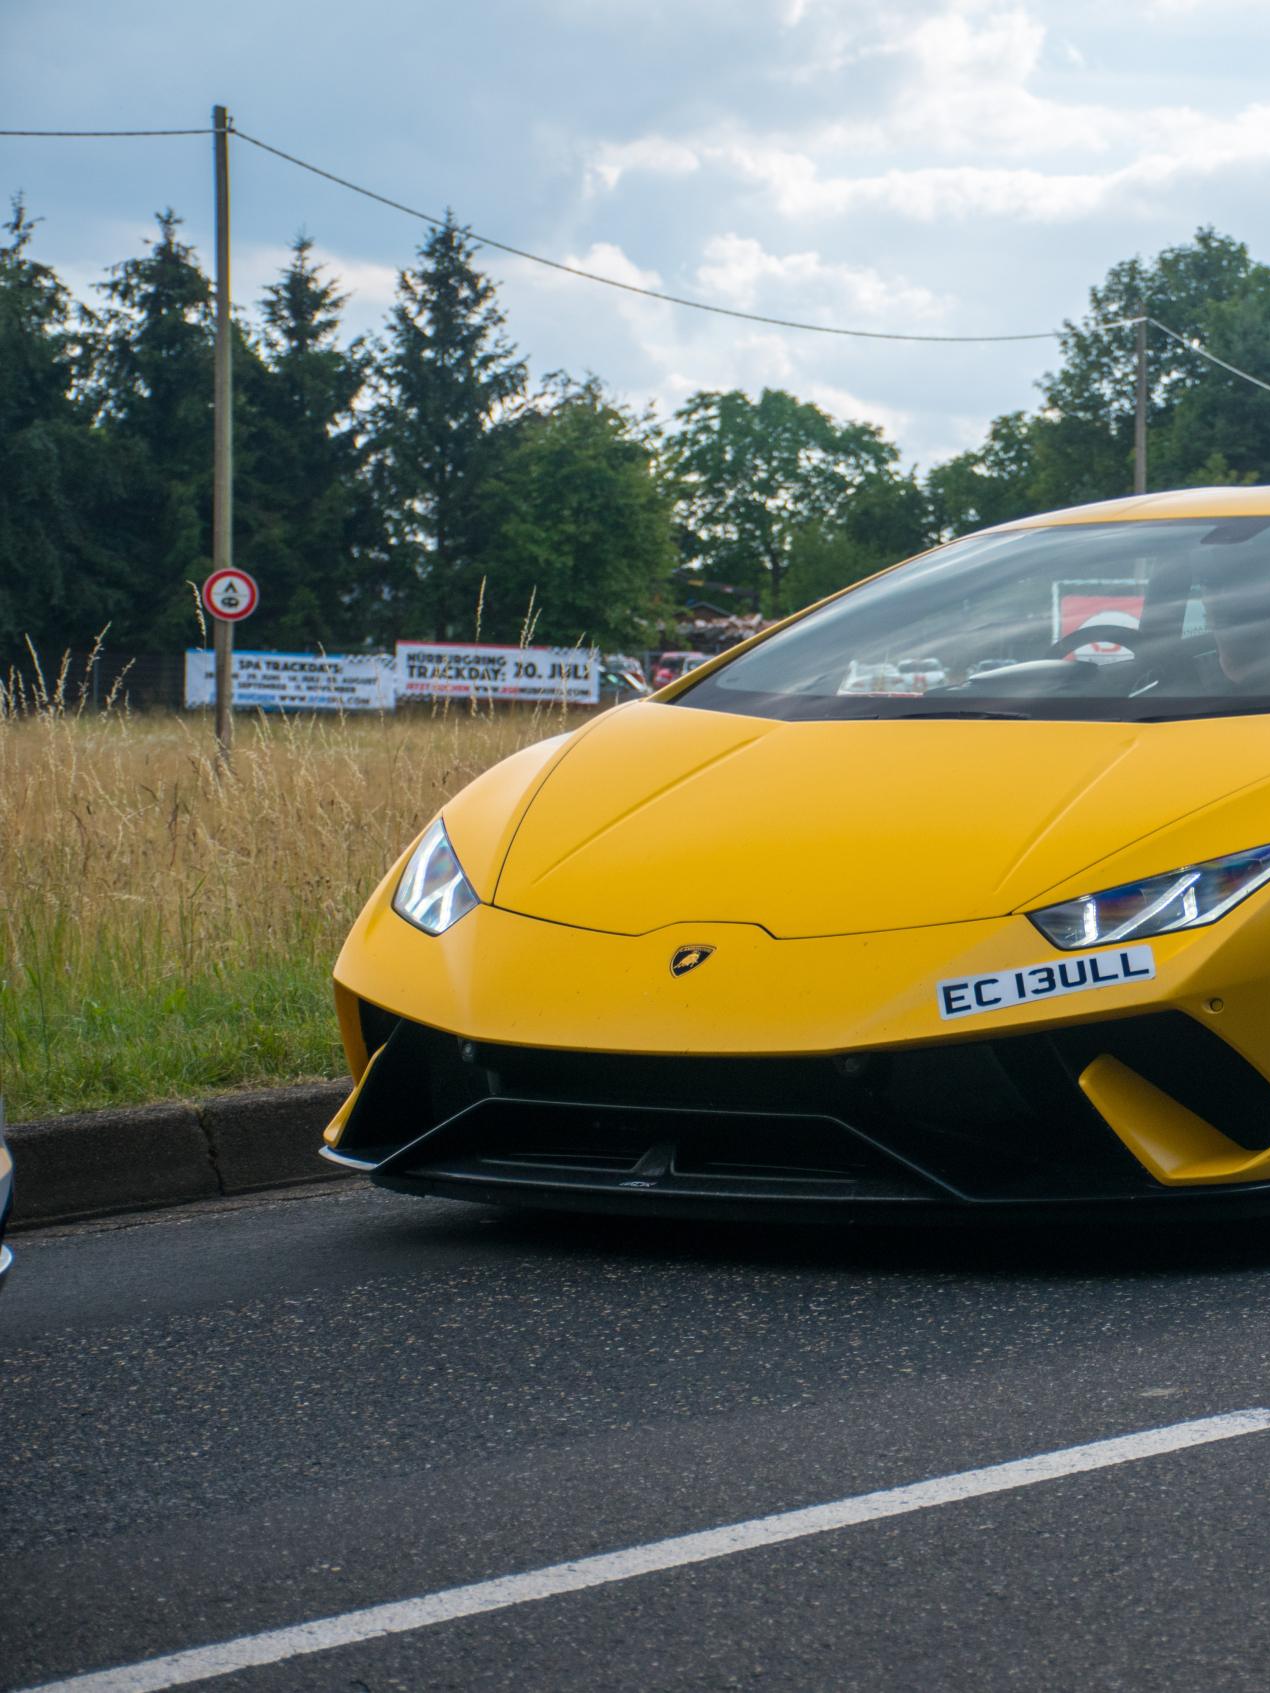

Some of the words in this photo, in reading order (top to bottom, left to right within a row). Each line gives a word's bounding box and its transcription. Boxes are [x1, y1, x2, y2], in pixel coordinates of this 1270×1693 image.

[407, 651, 507, 666] NÜRBURGRING
[239, 659, 262, 670] SPA
[266, 661, 343, 674] TRACKDAYS:
[407, 664, 506, 681] TRACKDAY:
[238, 682, 287, 690] SEPTEMBER
[942, 978, 1002, 1015] EC
